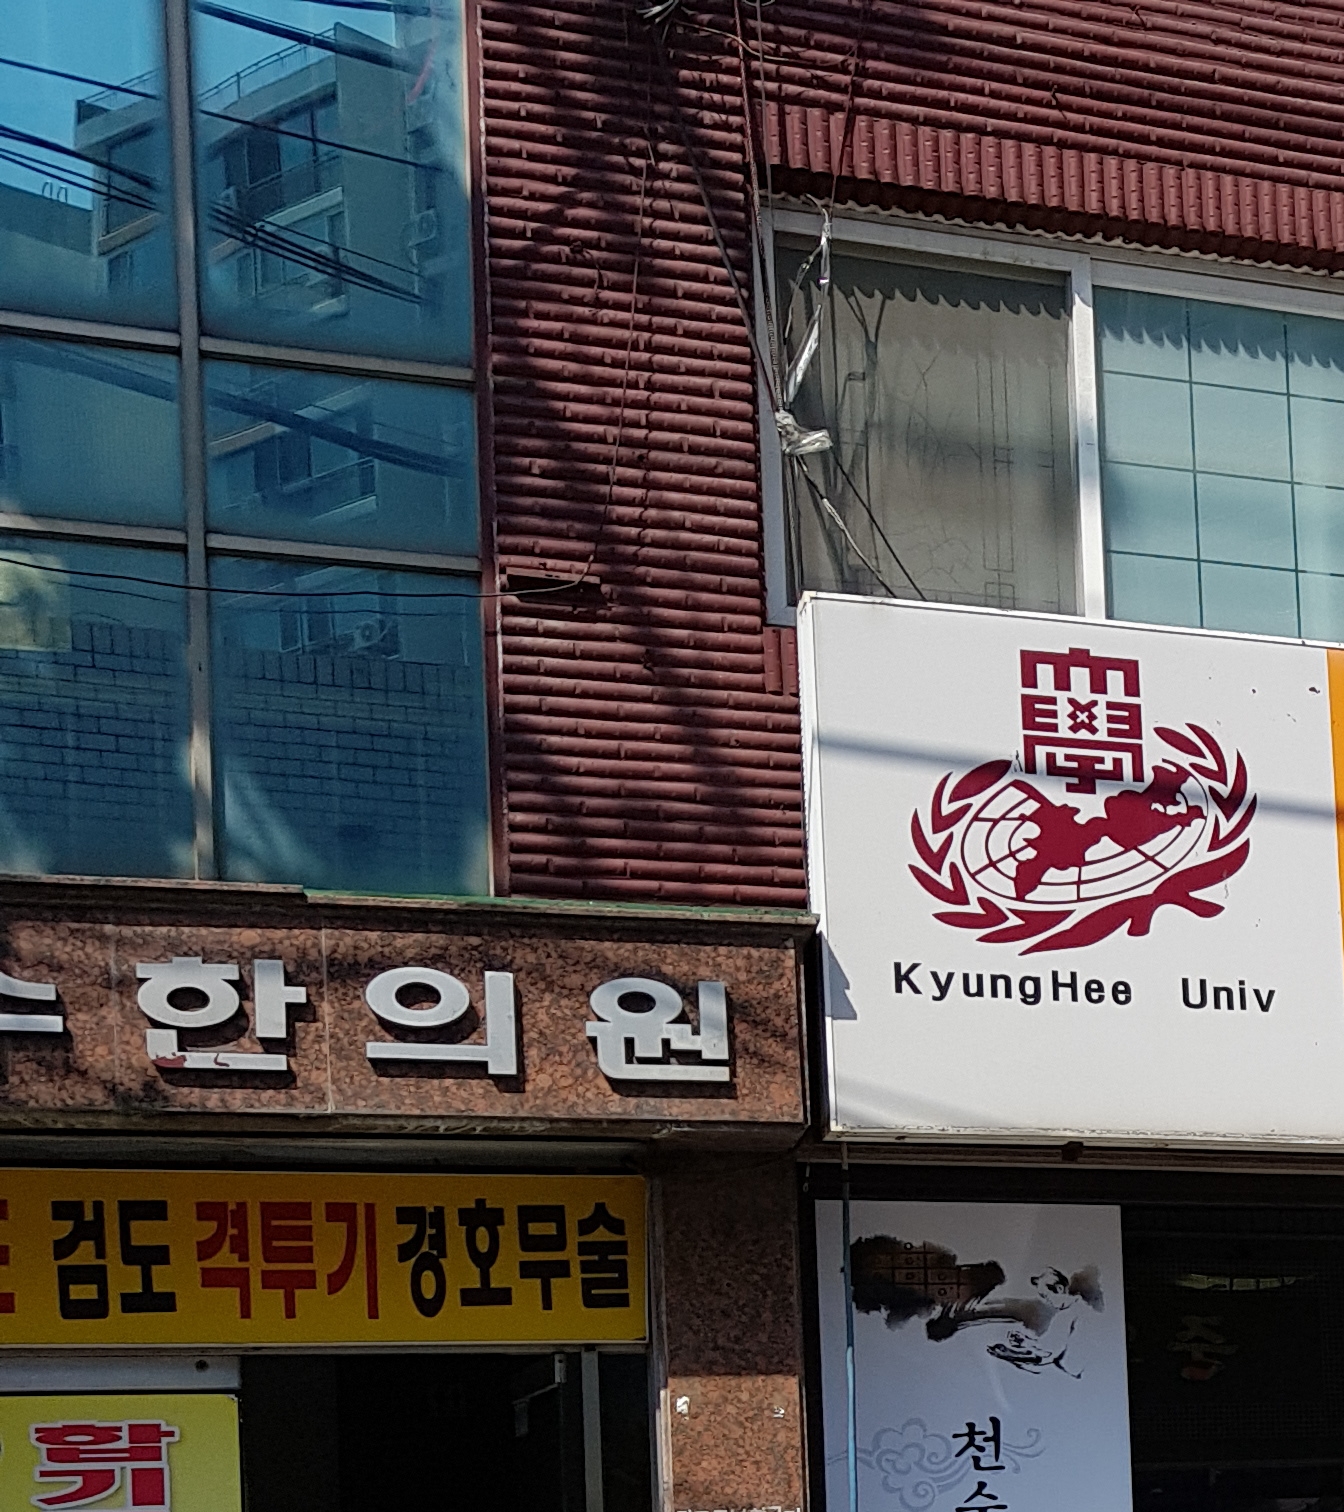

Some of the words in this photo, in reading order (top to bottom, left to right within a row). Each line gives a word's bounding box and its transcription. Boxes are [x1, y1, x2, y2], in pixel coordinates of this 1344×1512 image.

[892, 961, 1133, 1006] KyungHee
[1181, 976, 1277, 1013] Univ
[50, 1198, 178, 1322] 검도
[194, 1199, 381, 1321] 격투기
[394, 1196, 632, 1320] 경호무술
